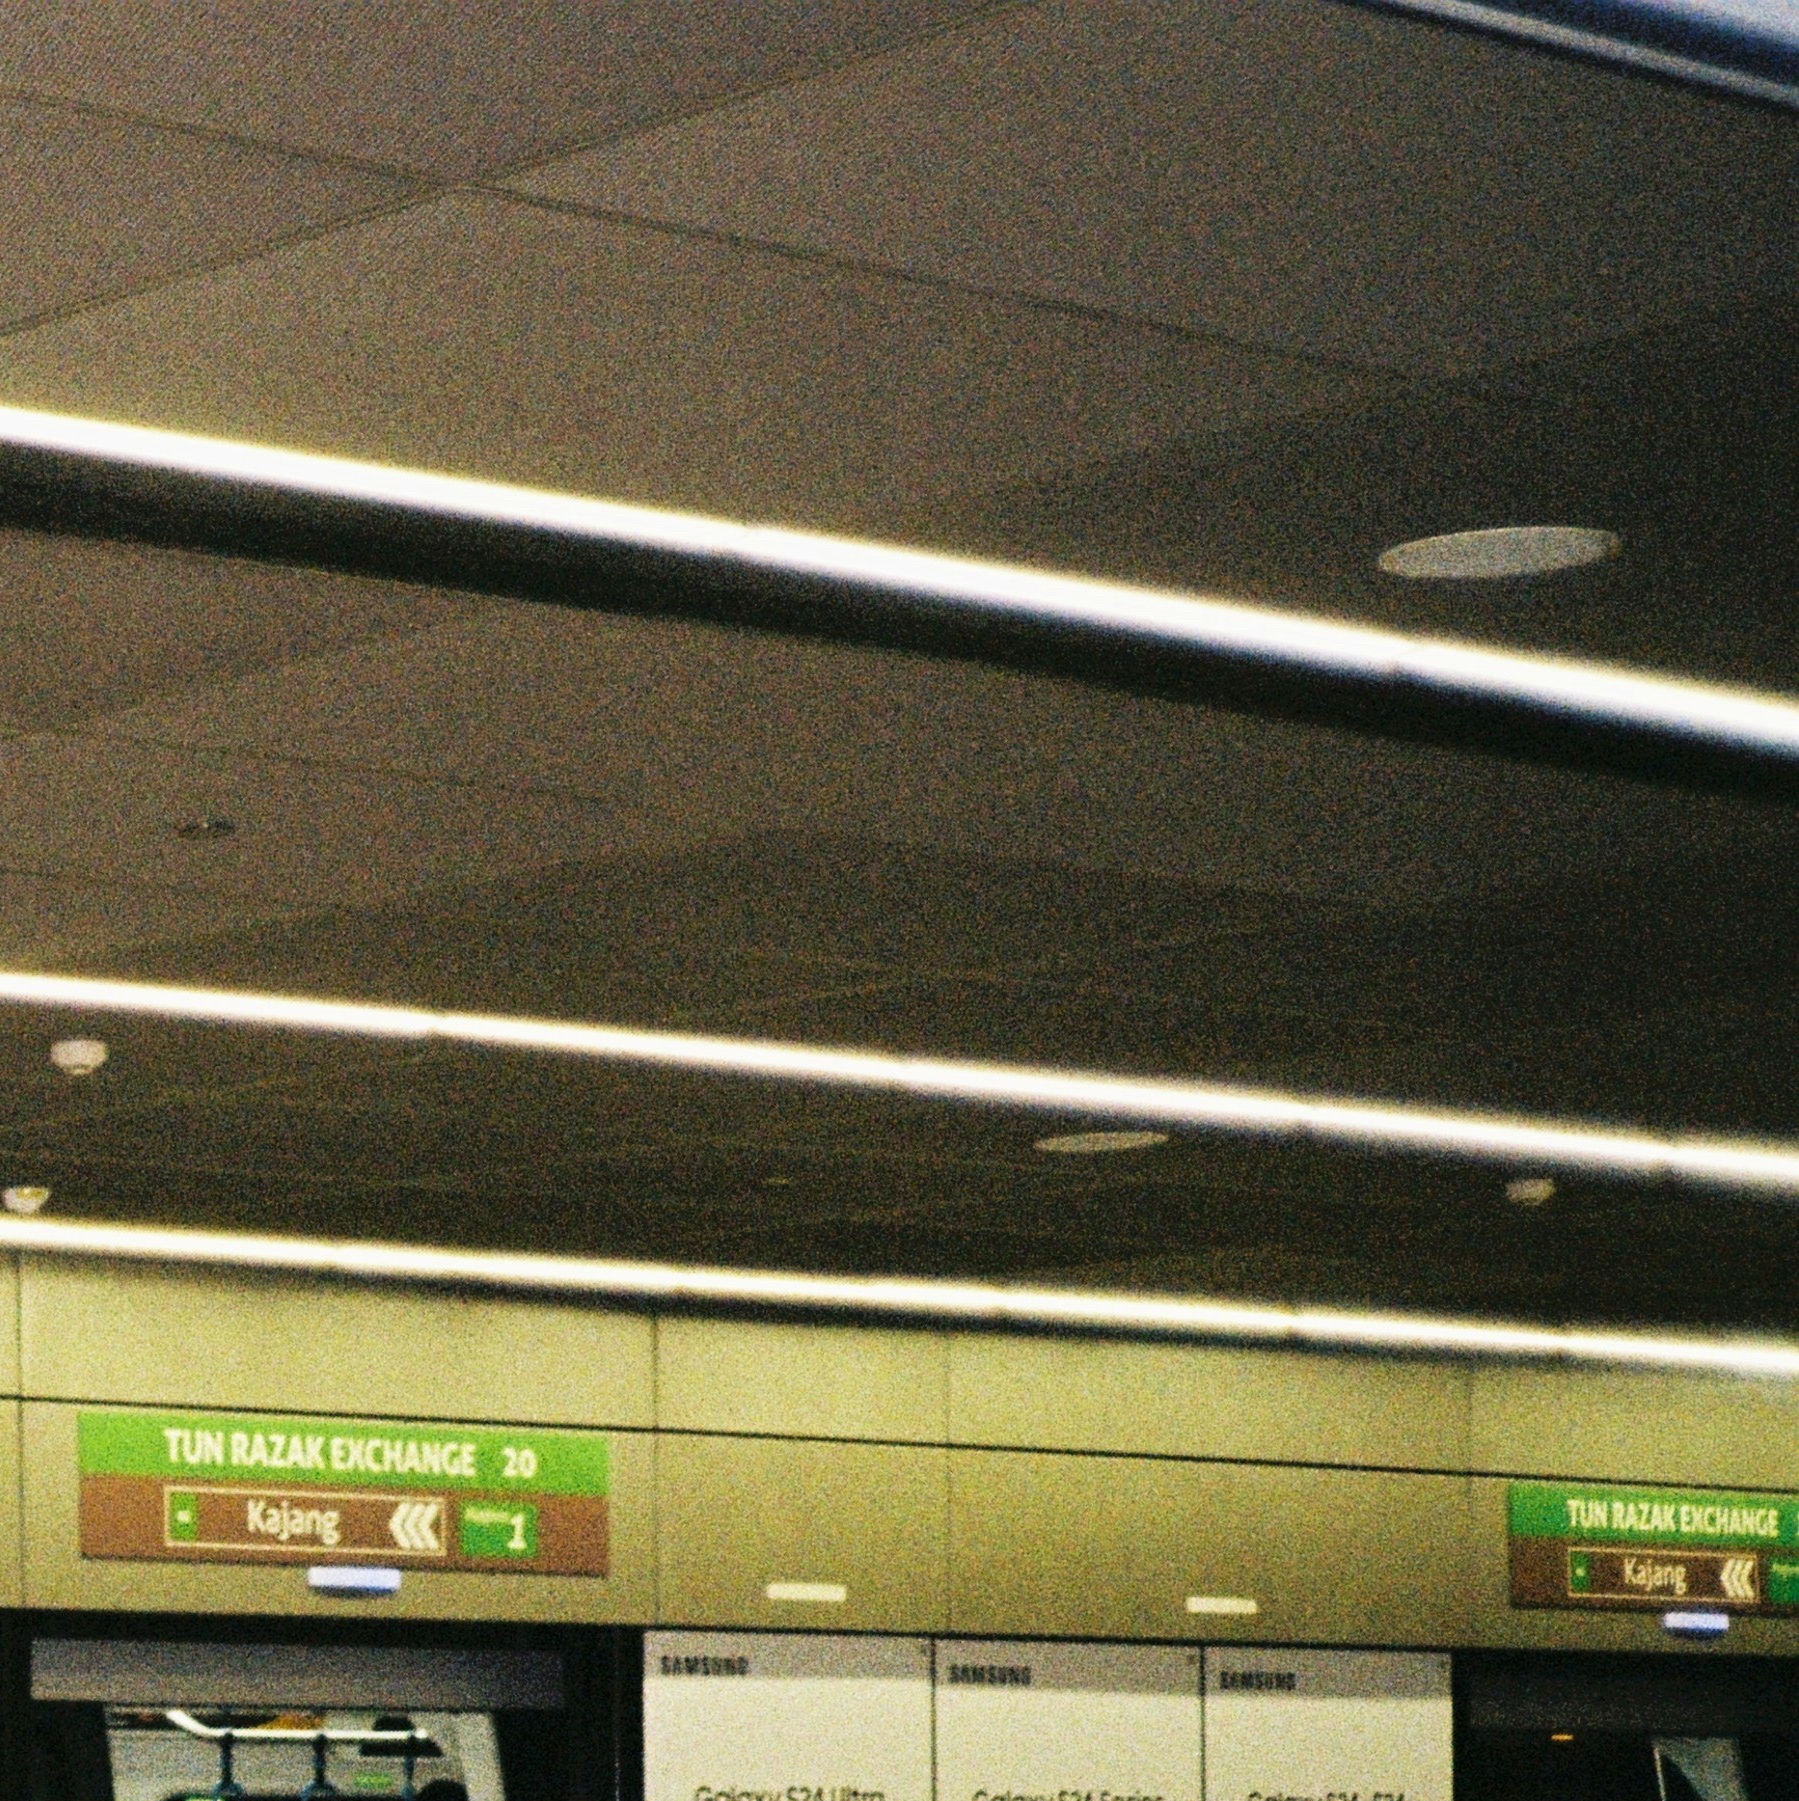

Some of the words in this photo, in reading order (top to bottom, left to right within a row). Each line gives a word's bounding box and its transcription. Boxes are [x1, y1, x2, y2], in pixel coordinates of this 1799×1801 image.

[162, 1428, 225, 1465] TUN
[230, 1431, 325, 1470] RAZAK
[330, 1437, 476, 1478] EXCHANGE
[500, 1447, 538, 1478] 20
[247, 1500, 340, 1547] Kajang
[505, 1512, 528, 1552] 1
[1567, 1499, 1608, 1529] TUN
[1611, 1501, 1677, 1532] RAZAK
[1680, 1505, 1778, 1537] EXCHANGE
[1624, 1558, 1688, 1596] Kajang
[659, 1656, 749, 1676] SAMSUNG
[948, 1665, 1033, 1686] SAMSUNG
